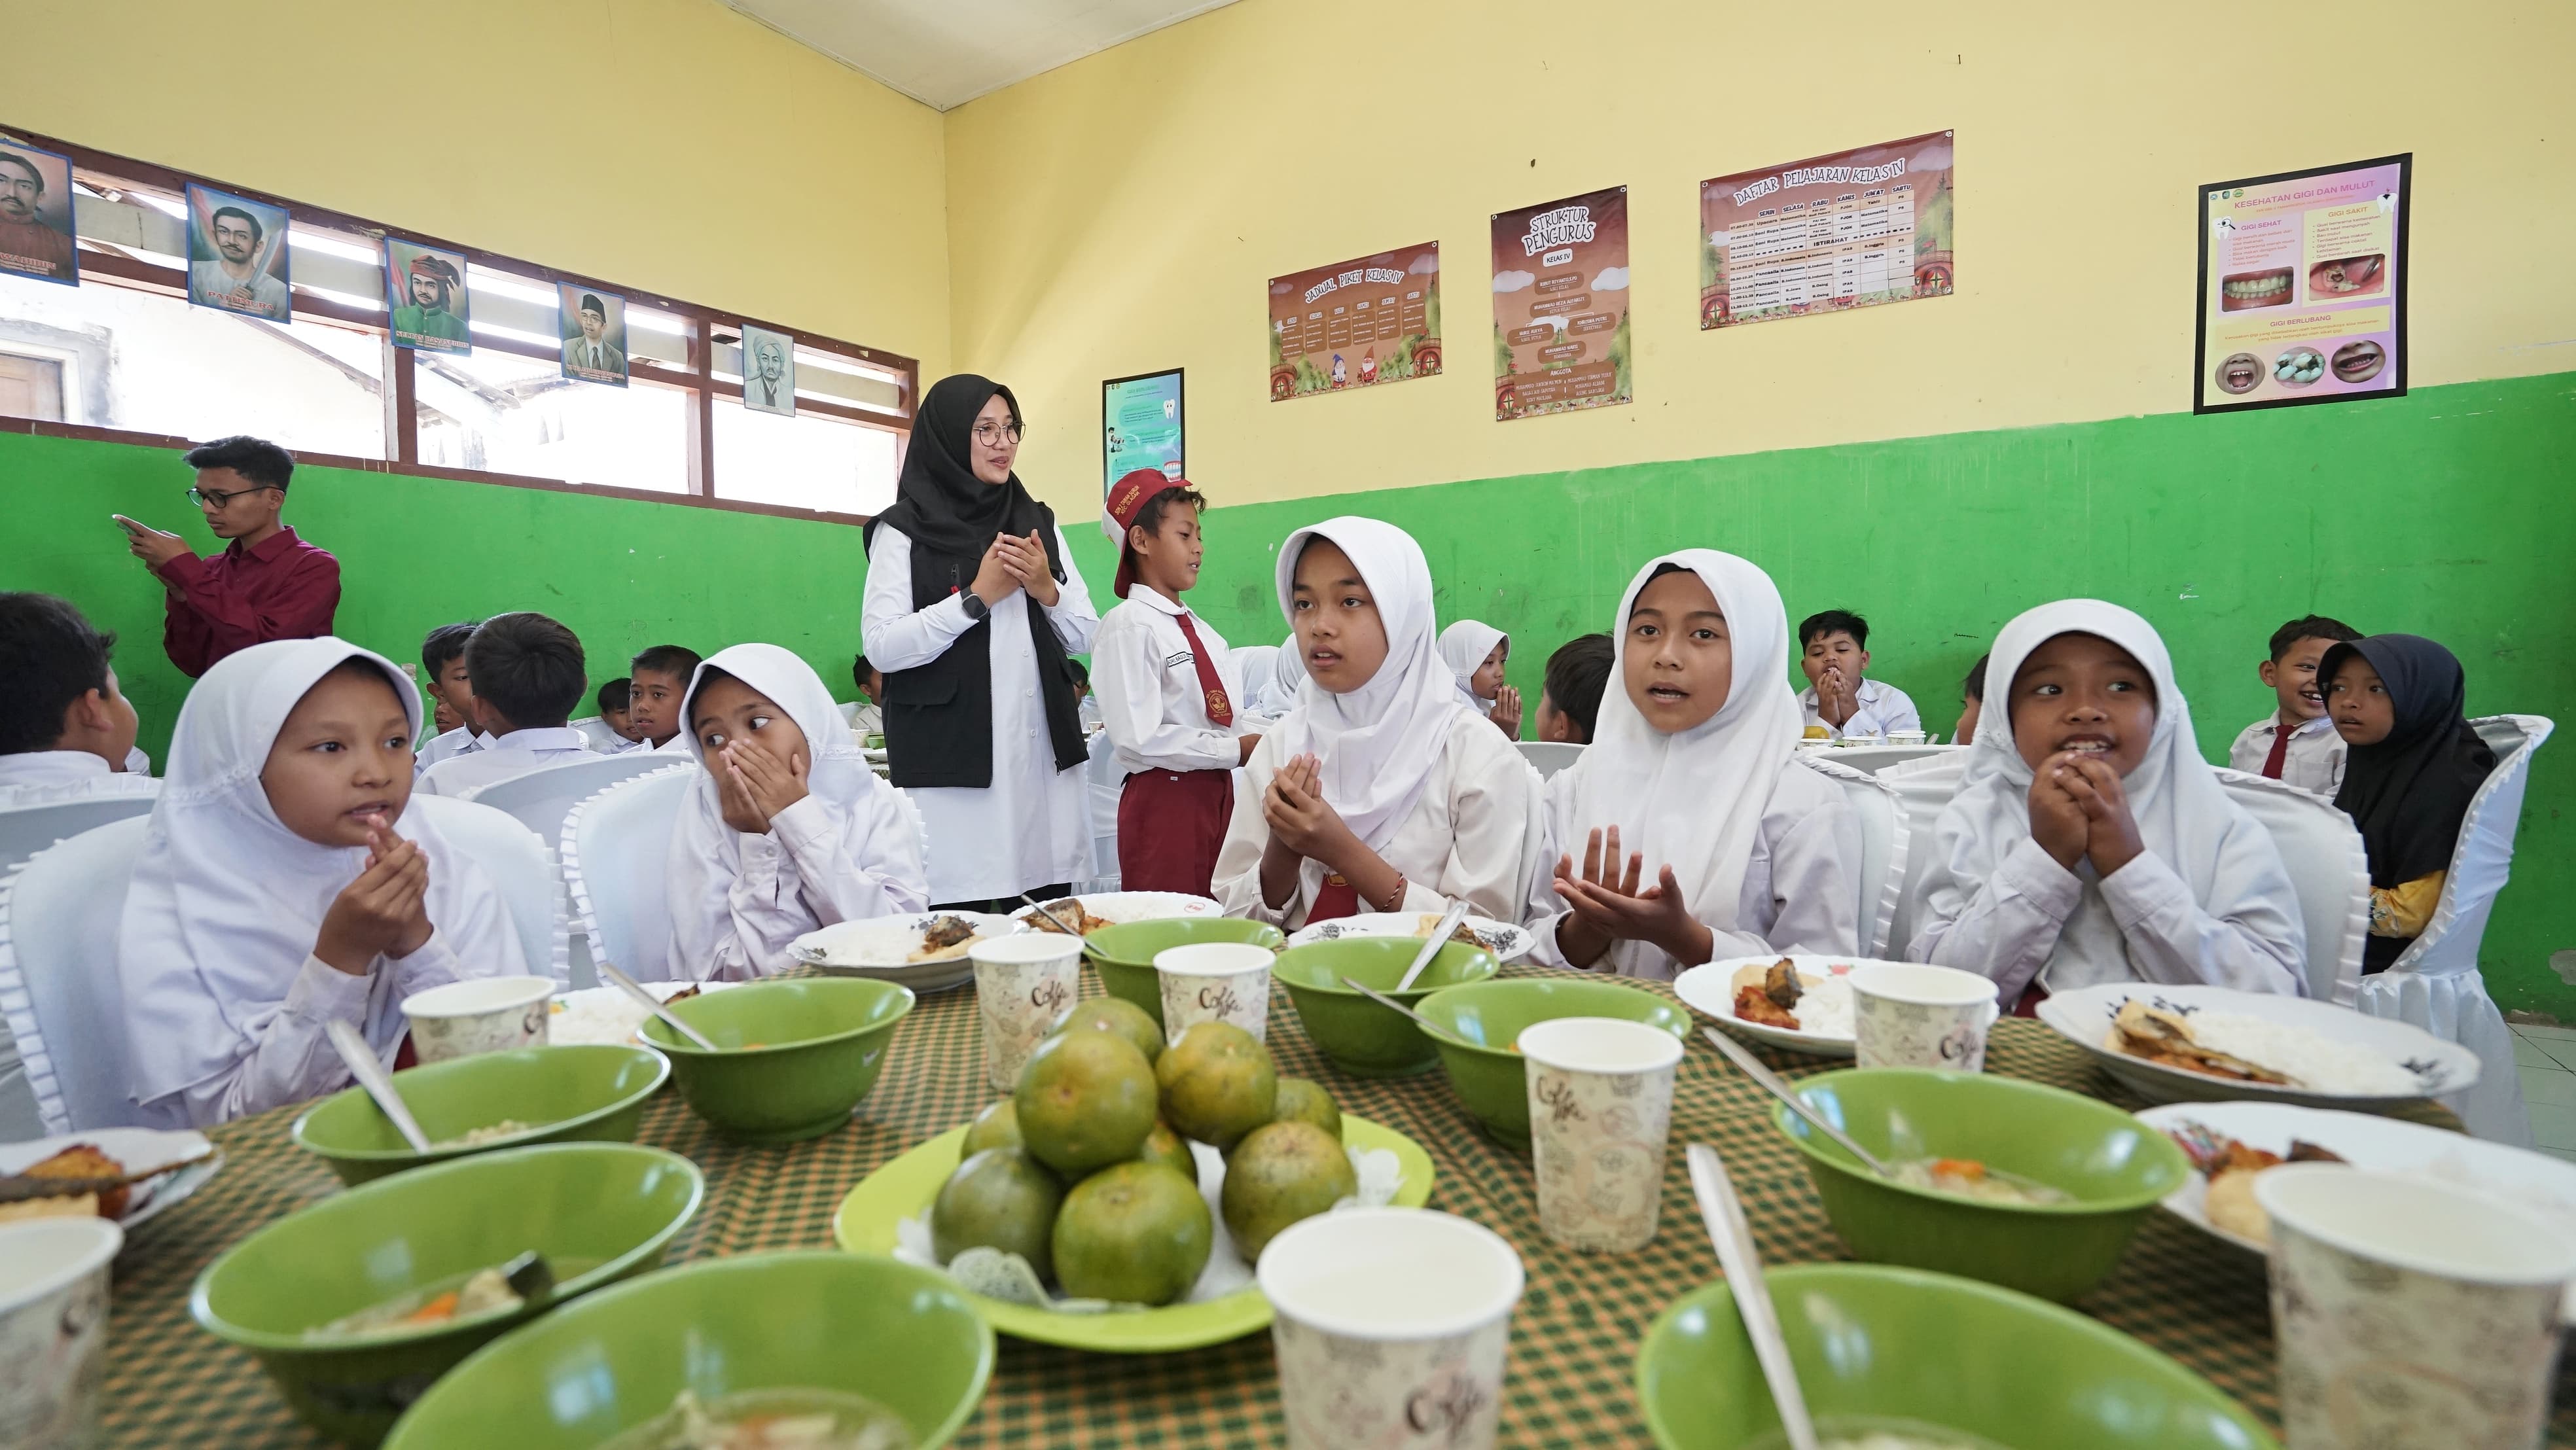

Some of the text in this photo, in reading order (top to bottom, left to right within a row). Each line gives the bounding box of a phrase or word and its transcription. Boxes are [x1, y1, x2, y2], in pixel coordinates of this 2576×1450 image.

[1736, 160, 1905, 204] DAFTAR PELAJARAN KELAS IV
[2234, 195, 2291, 209] KESEHATAN
[2294, 190, 2314, 200] GIGI
[2317, 187, 2337, 196] DAN
[2340, 180, 2376, 192] MULUT
[1532, 209, 1587, 232] STRUKTUR
[2257, 220, 2281, 228] SEHAT
[1524, 224, 1594, 253] PENGURUS
[1814, 237, 1848, 247] ISTIRAHAT
[1547, 255, 1563, 263] KELAS
[1307, 270, 1403, 302] JADWAL PIKET KELAS IV
[207, 291, 275, 311] PATTIMURA
[2287, 315, 2331, 325] BERLUBANG
